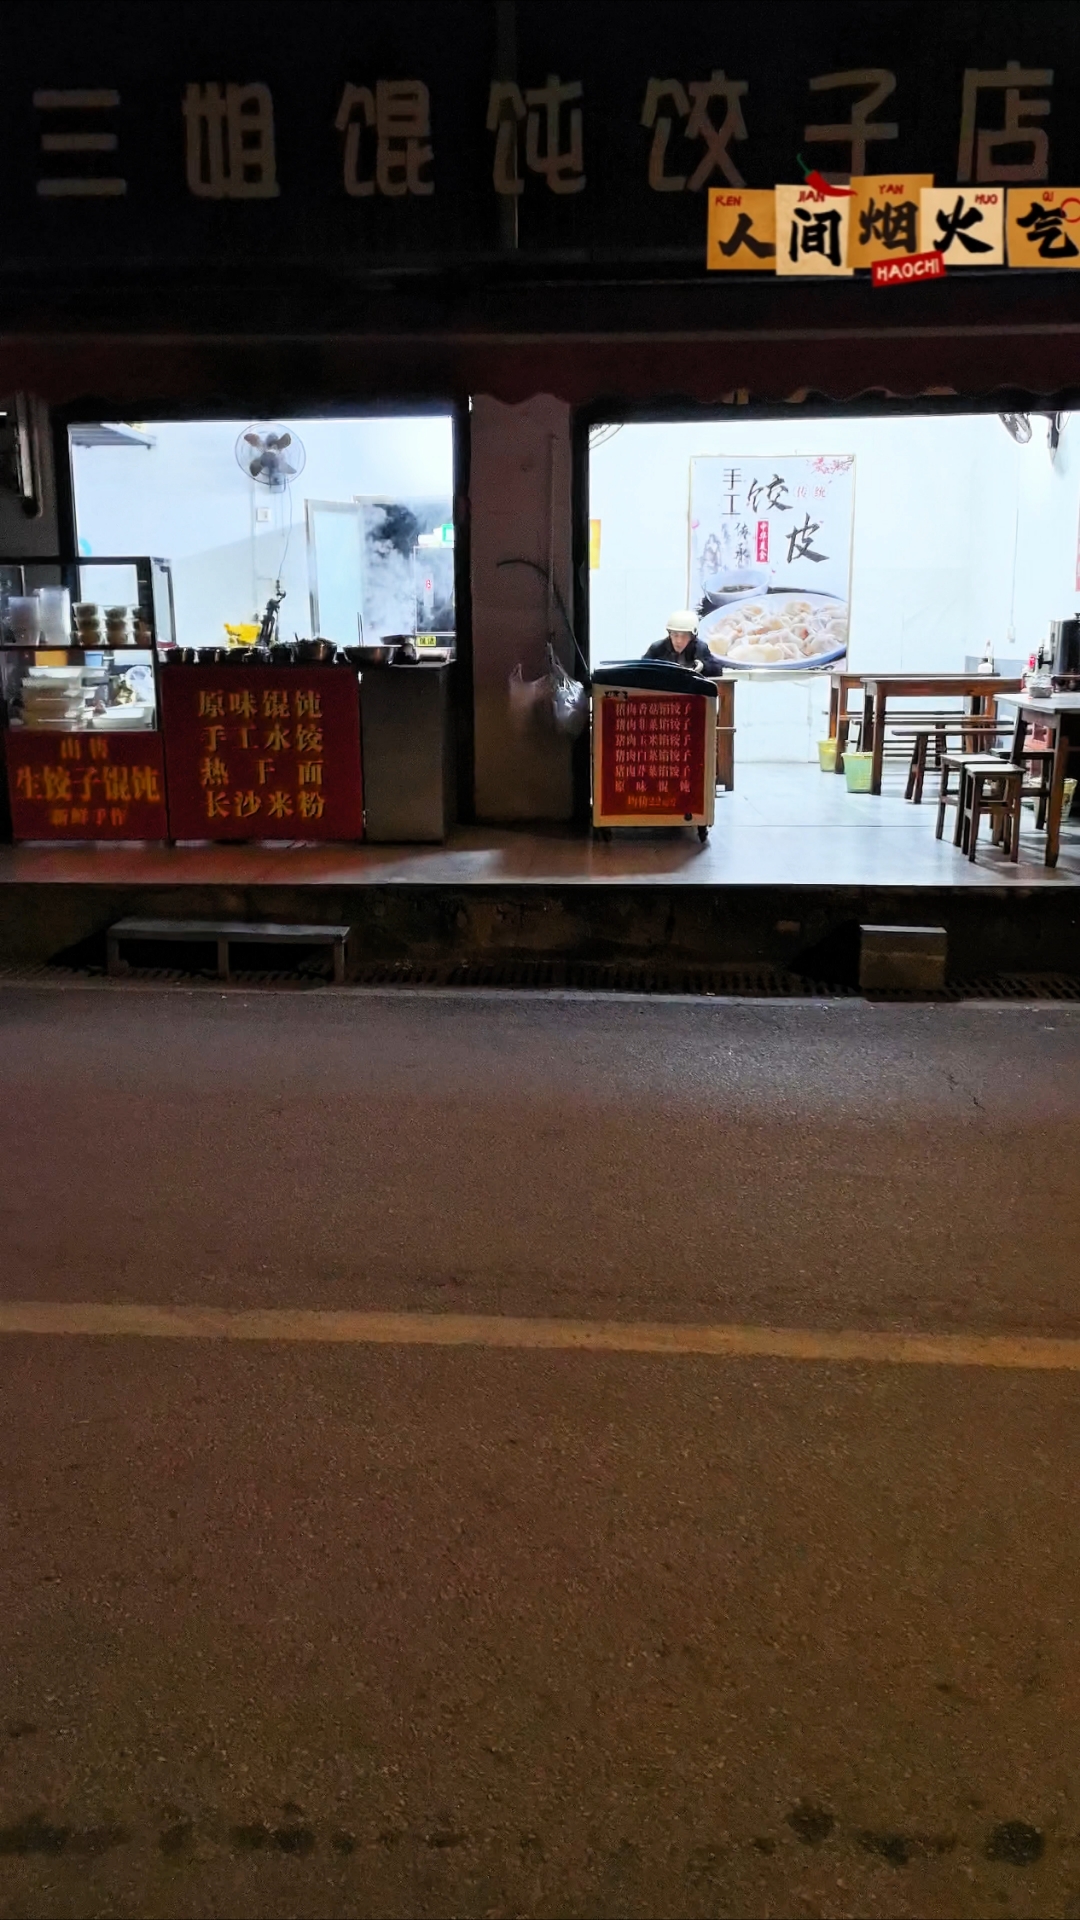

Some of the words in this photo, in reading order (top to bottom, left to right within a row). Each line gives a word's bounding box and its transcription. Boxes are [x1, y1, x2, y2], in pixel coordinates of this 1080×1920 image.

[33, 60, 1054, 198] 三姐馄饨饺子店
[721, 468, 742, 515] 手工
[198, 689, 323, 718] 原味馄饨
[200, 723, 323, 752] 手工水饺
[16, 765, 161, 801] 生饺子馄饨
[200, 757, 324, 787] 热干面
[205, 790, 325, 819] 长沙米粉
